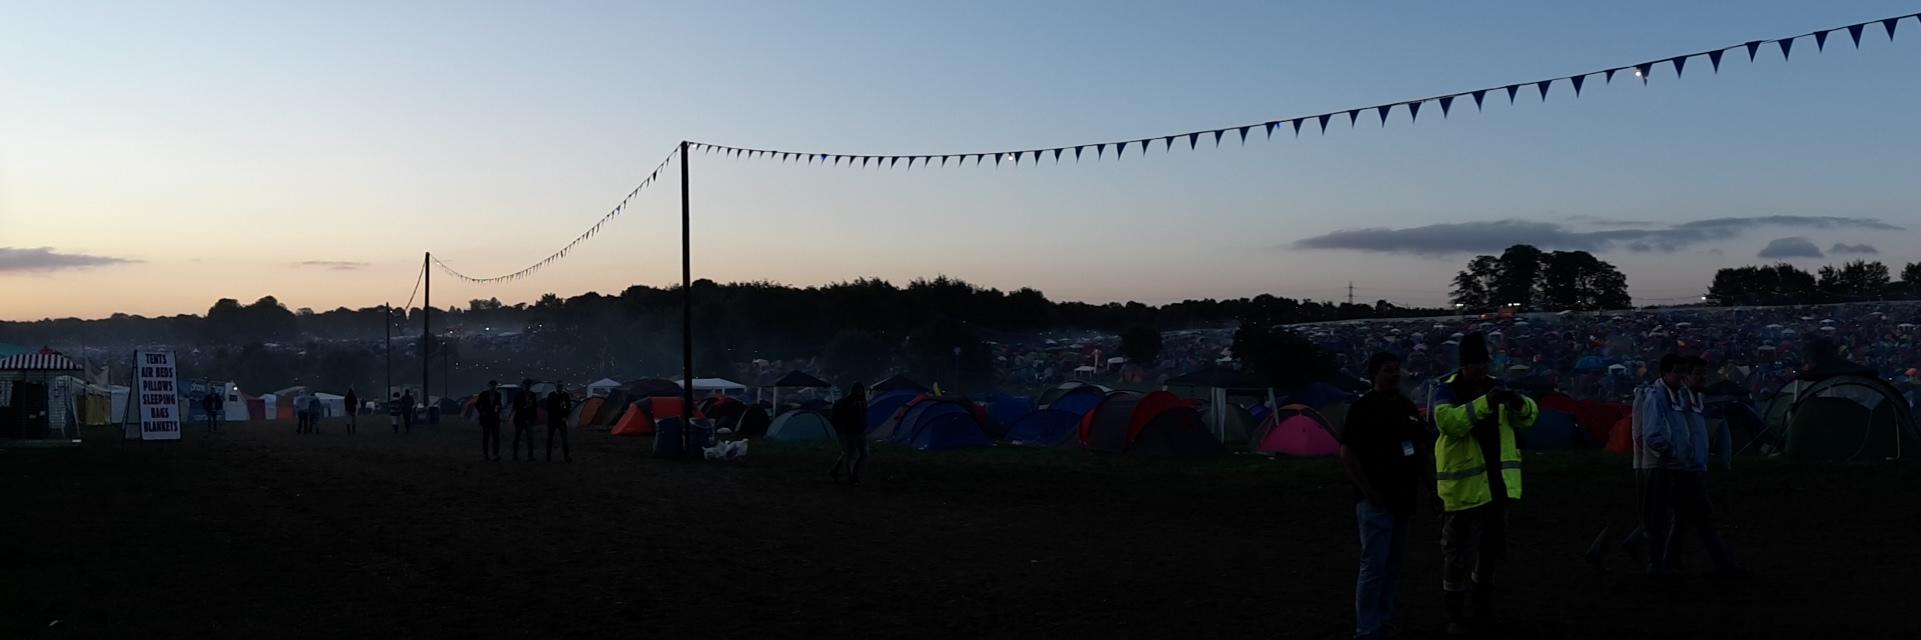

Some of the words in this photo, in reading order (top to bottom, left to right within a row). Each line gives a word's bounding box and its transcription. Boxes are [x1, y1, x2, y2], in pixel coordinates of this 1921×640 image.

[145, 353, 167, 364] TENTS
[141, 367, 153, 378] AIR
[156, 367, 173, 378] BEDS
[143, 380, 173, 391] PILLOWS
[142, 394, 176, 405] SLEEPING
[151, 407, 169, 418] BAGS
[144, 421, 178, 432] BLANKETS
